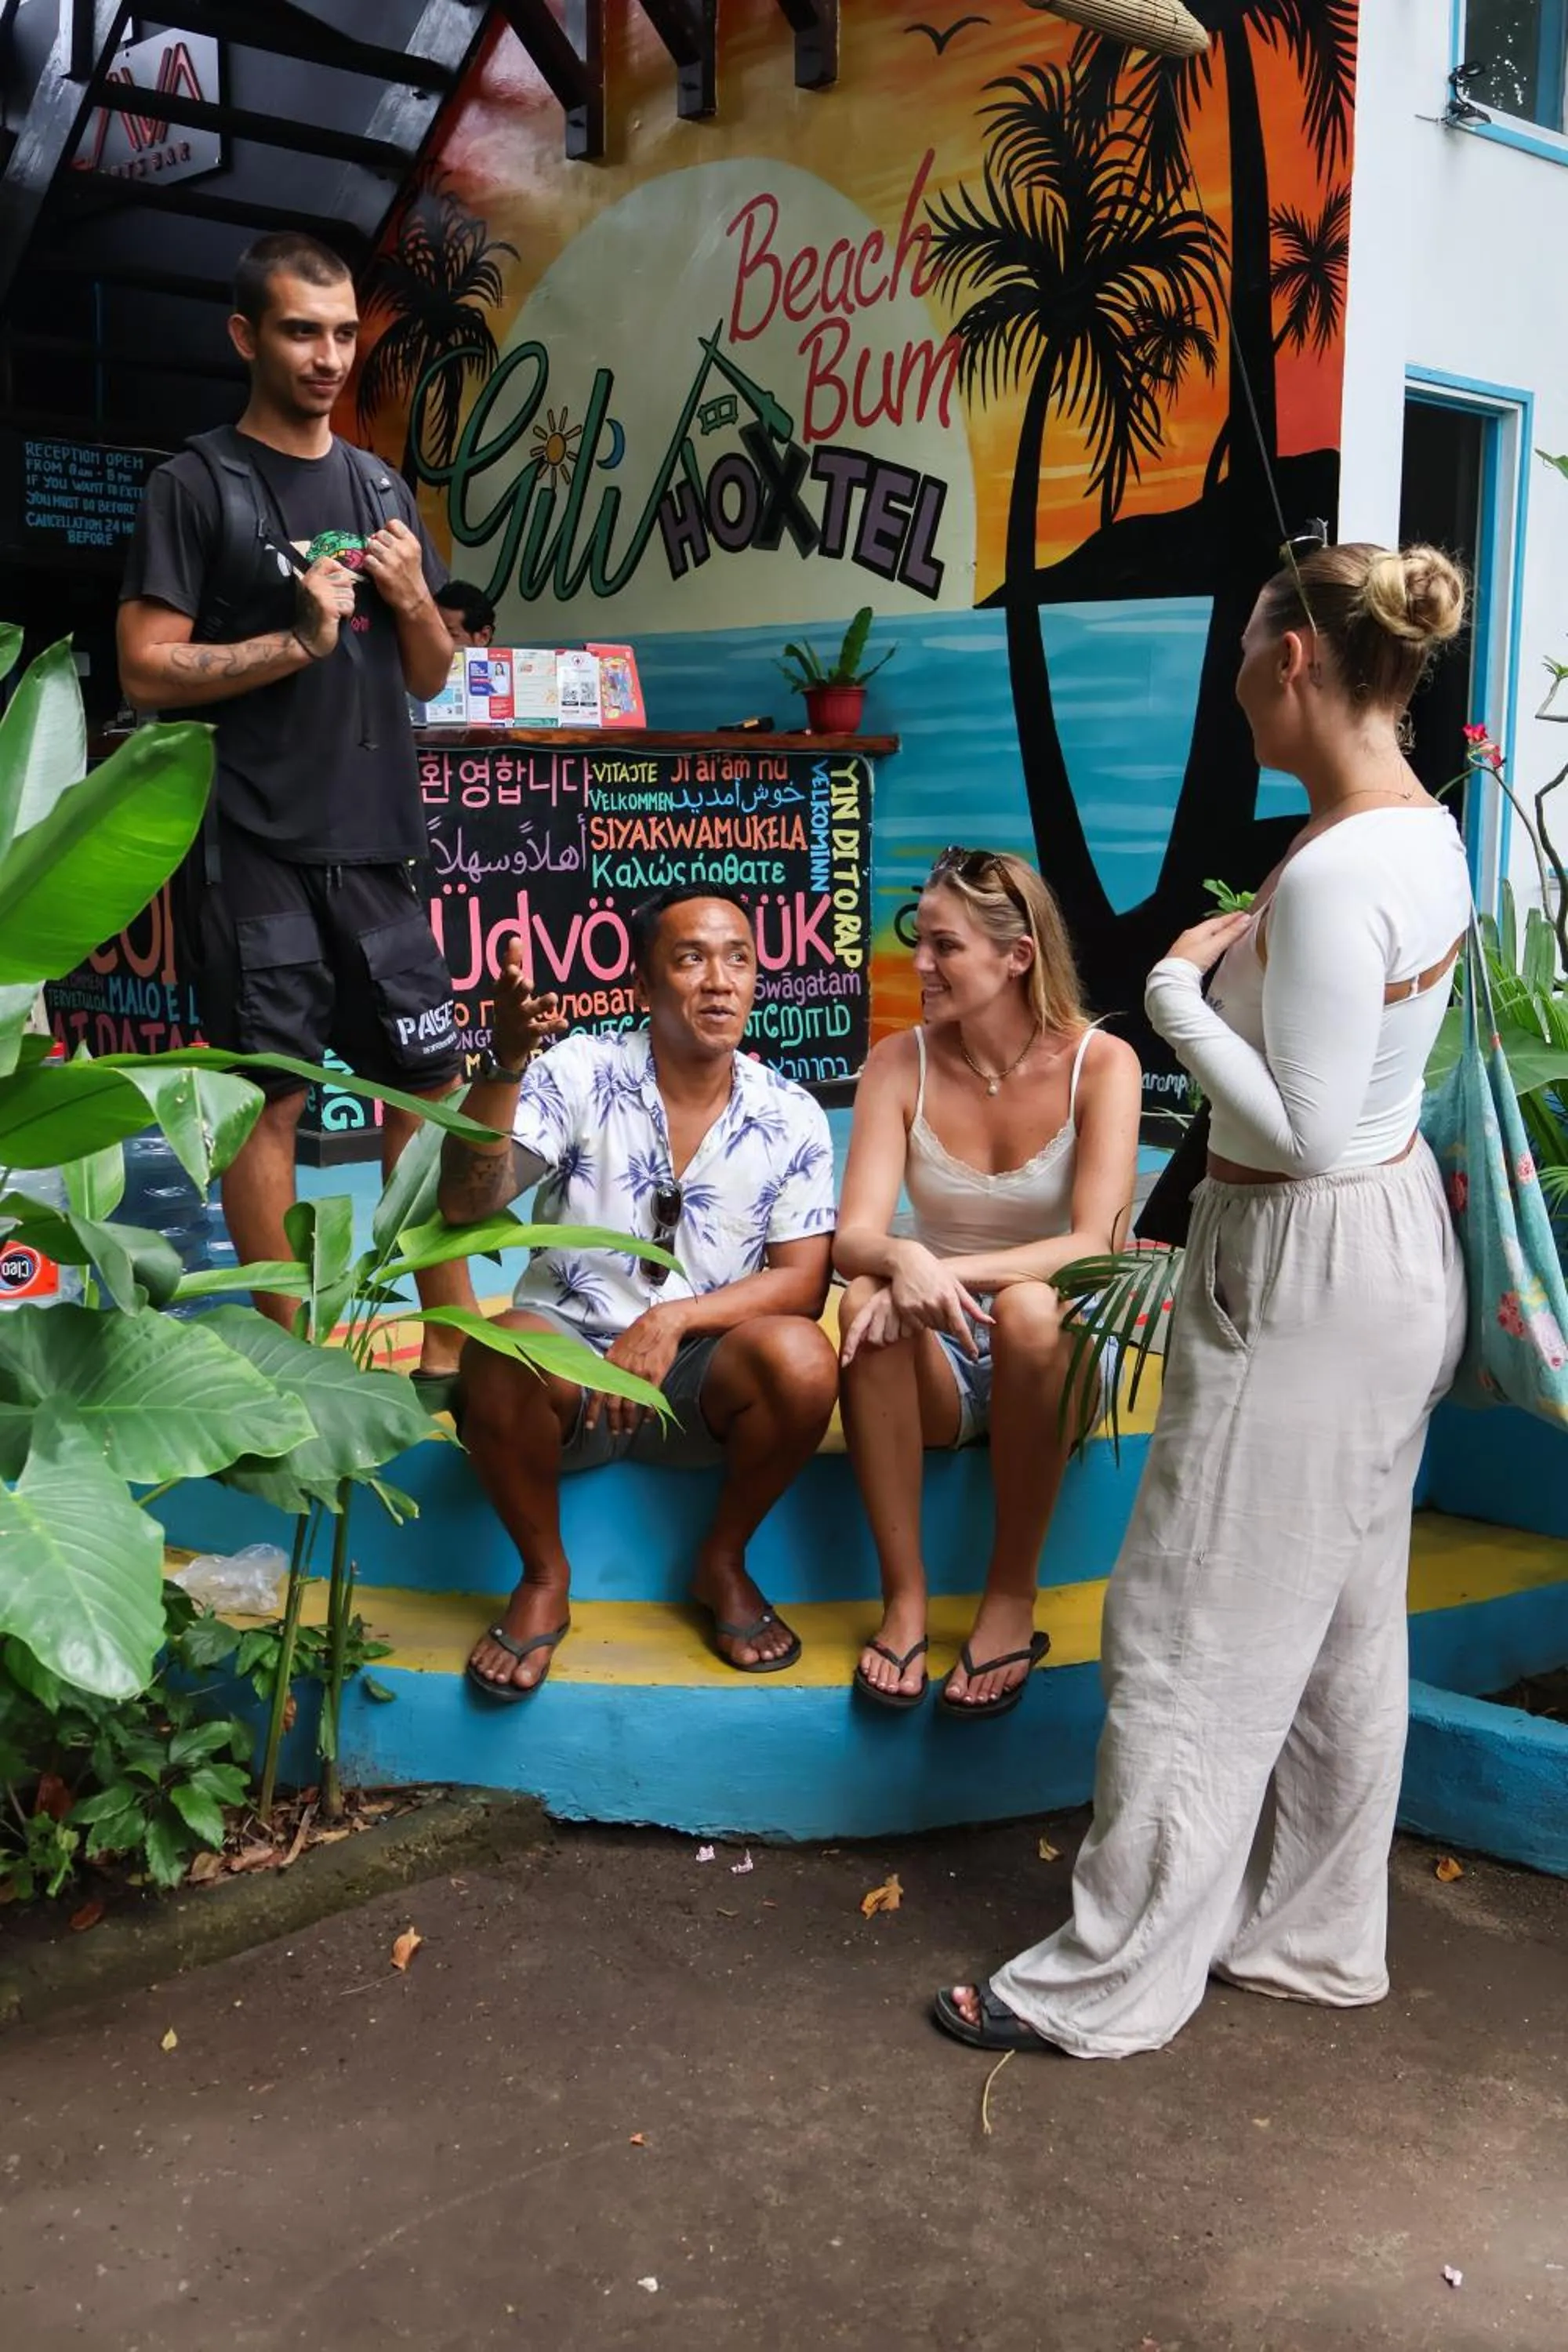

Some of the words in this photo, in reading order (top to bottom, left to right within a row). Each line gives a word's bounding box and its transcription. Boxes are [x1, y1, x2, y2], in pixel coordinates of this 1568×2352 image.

[727, 148, 949, 343] Beach
[798, 317, 969, 444] Bum
[25, 441, 100, 464] RECEPTION
[25, 458, 63, 474] FROM
[410, 339, 655, 605] Gili
[418, 753, 593, 808] 환영합니다
[592, 761, 658, 783] VITAJTE
[589, 788, 673, 812] VELKOMMEN
[590, 815, 808, 851] SIYAKWAMUKELA
[810, 758, 831, 892] VELKOMINN
[2, 1260, 29, 1279] Cleo
